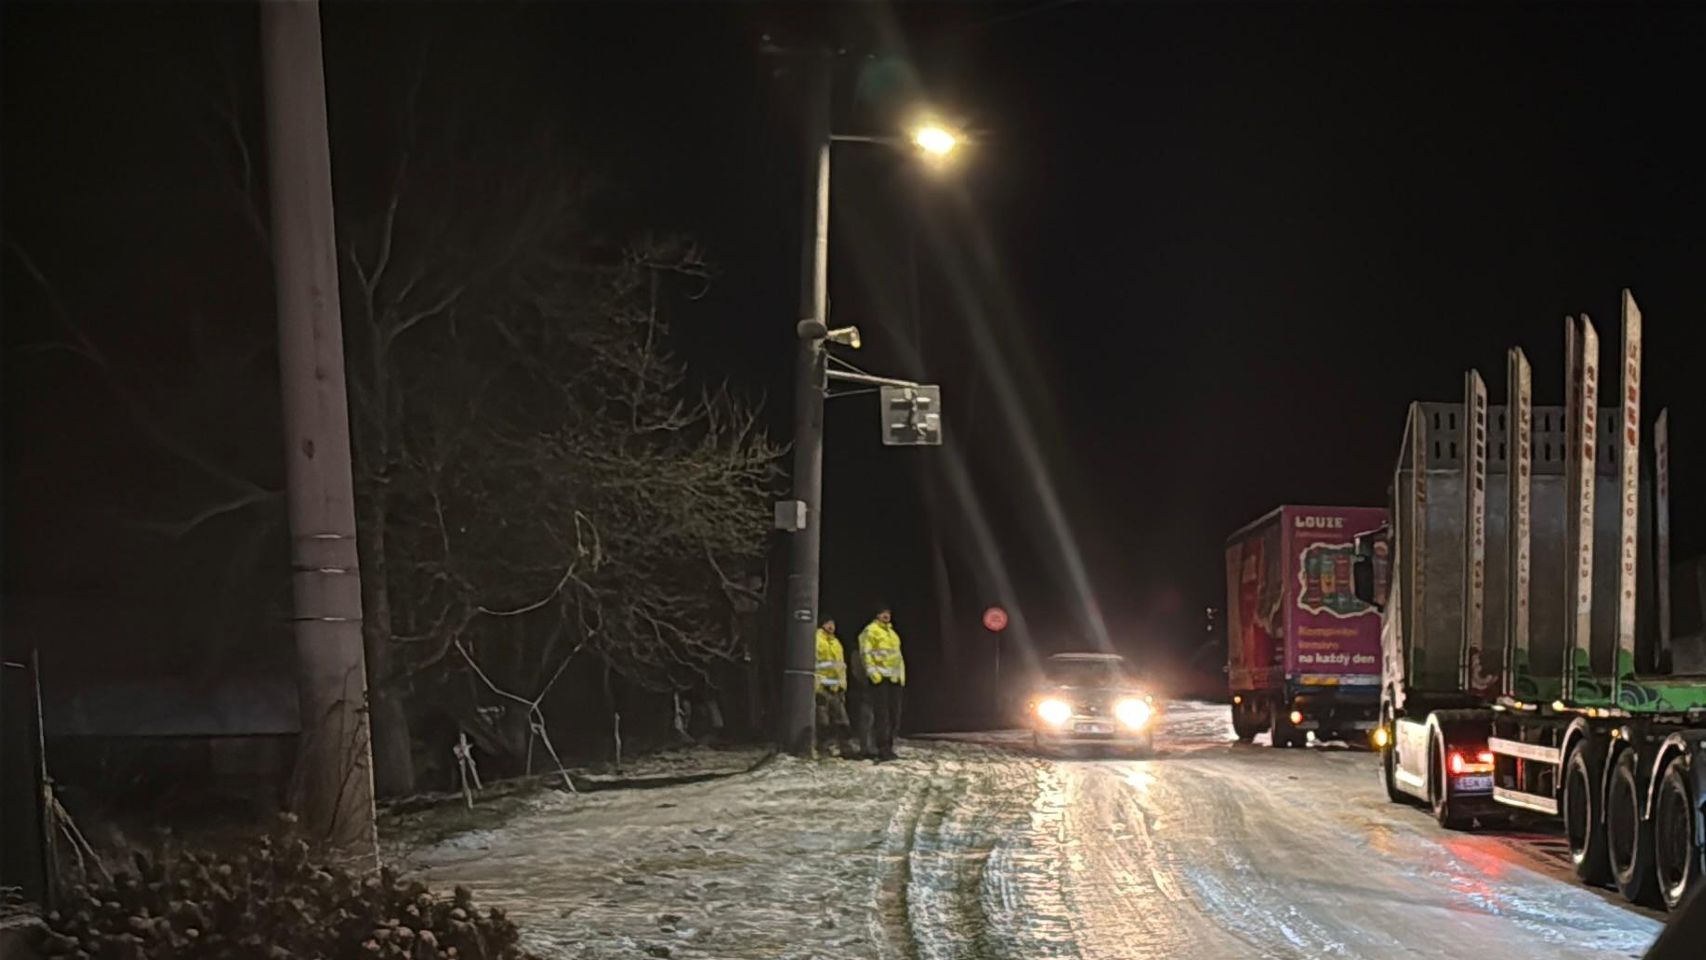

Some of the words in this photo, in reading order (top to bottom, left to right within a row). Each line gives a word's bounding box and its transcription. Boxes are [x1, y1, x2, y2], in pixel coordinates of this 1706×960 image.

[1624, 535, 1634, 572] ALU
[1298, 654, 1314, 664] na
[1315, 652, 1351, 667] každý
[1352, 653, 1376, 664] den
